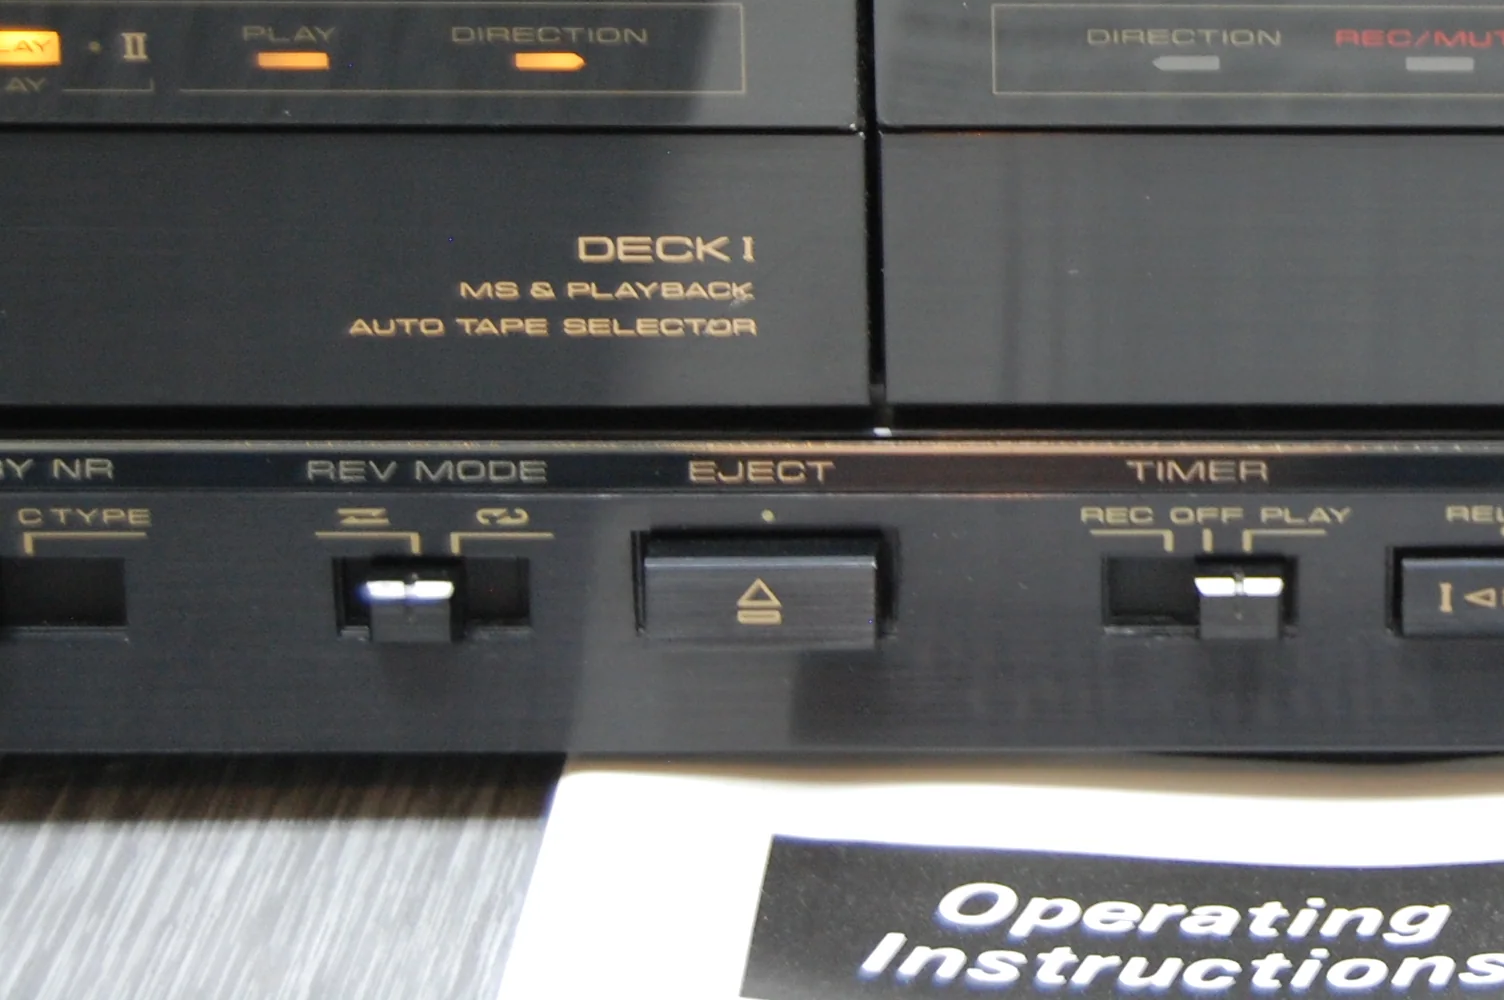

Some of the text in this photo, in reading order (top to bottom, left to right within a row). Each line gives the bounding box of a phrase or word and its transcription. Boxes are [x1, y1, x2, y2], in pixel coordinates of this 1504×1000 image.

[241, 25, 337, 44] PLAY
[451, 26, 649, 45] DIRECTION
[1086, 28, 1282, 47] DIRECTION
[577, 236, 731, 263] DECK
[460, 281, 756, 300] MS & PLAYBACK
[348, 318, 758, 338] AUTO TAPE SELECTOR
[52, 458, 115, 480] NR
[307, 460, 548, 482] REV MODE
[688, 460, 835, 484] EJECT
[1126, 460, 1270, 483] TIMER
[49, 507, 153, 526] TYPE
[1080, 507, 1352, 525] REC OFF PLAY
[935, 882, 1452, 946] Operating
